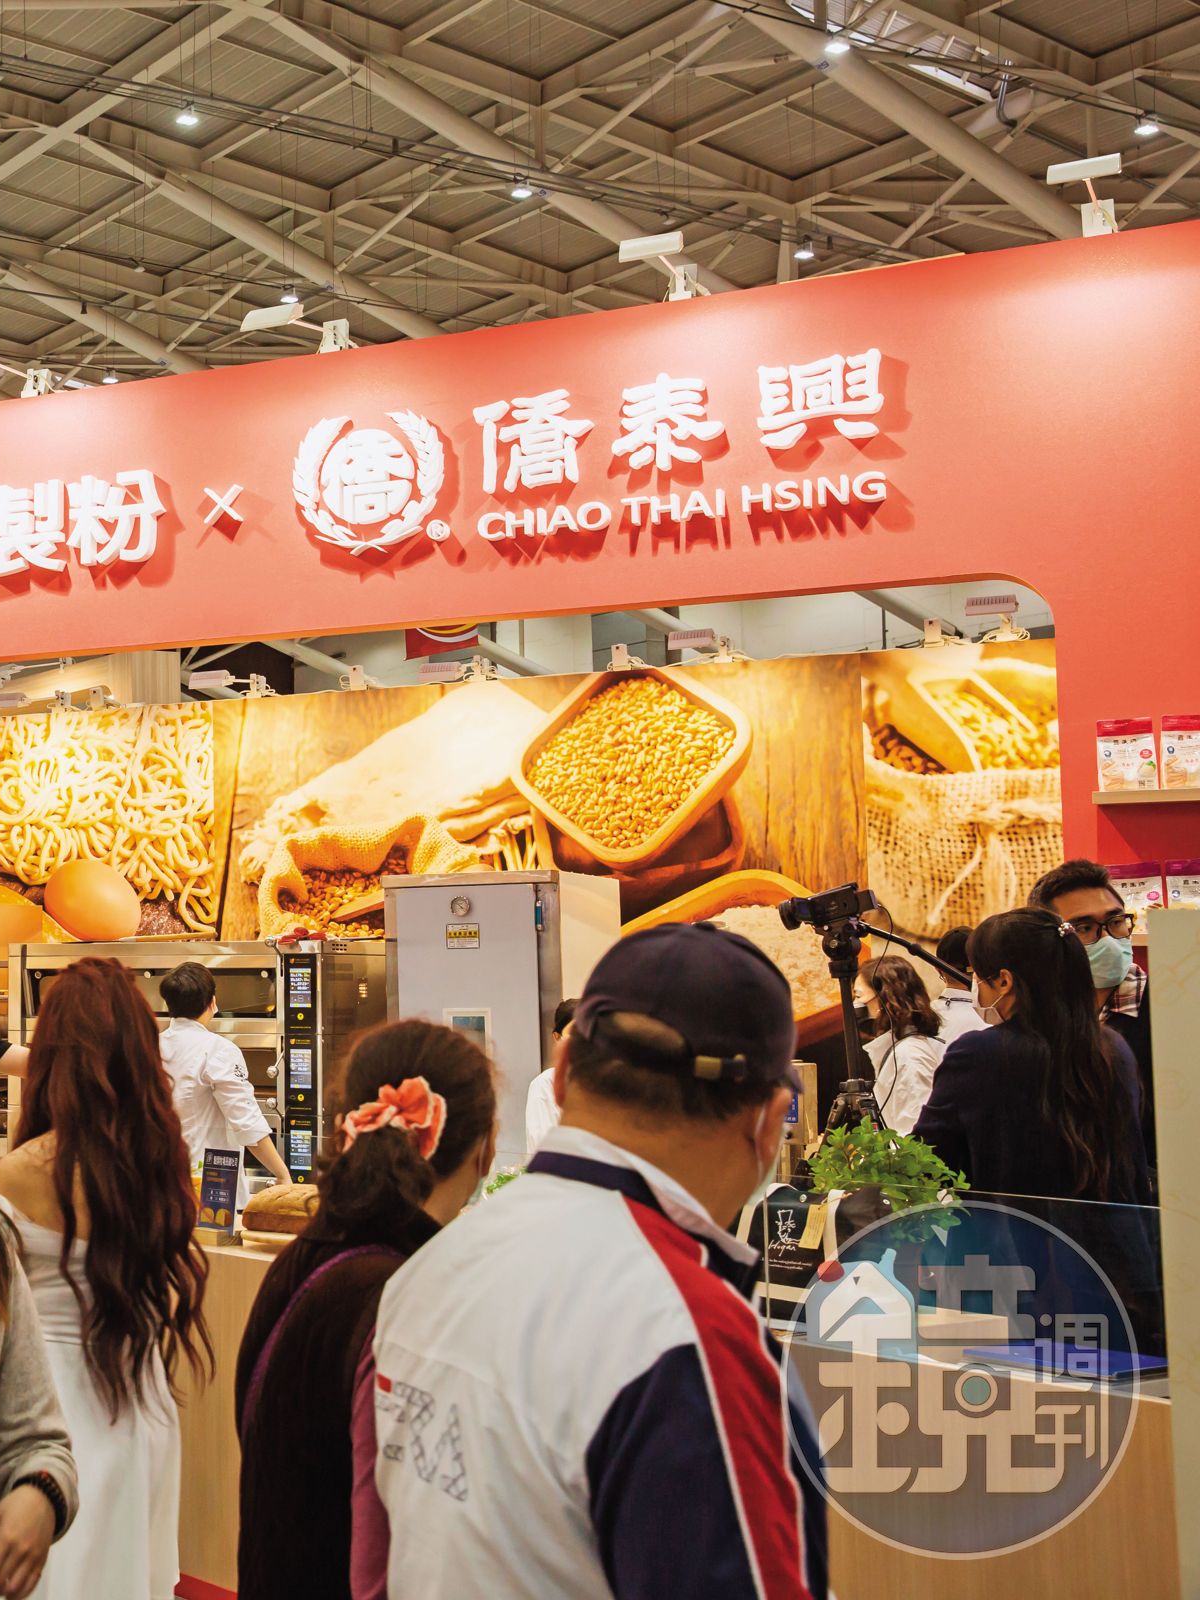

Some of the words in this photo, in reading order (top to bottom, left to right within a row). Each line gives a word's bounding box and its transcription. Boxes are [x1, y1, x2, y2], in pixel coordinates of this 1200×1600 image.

[473, 348, 884, 494] 僑泰興
[477, 501, 612, 542] CHIAO
[629, 490, 726, 527] THAI
[742, 470, 888, 514] HSING
